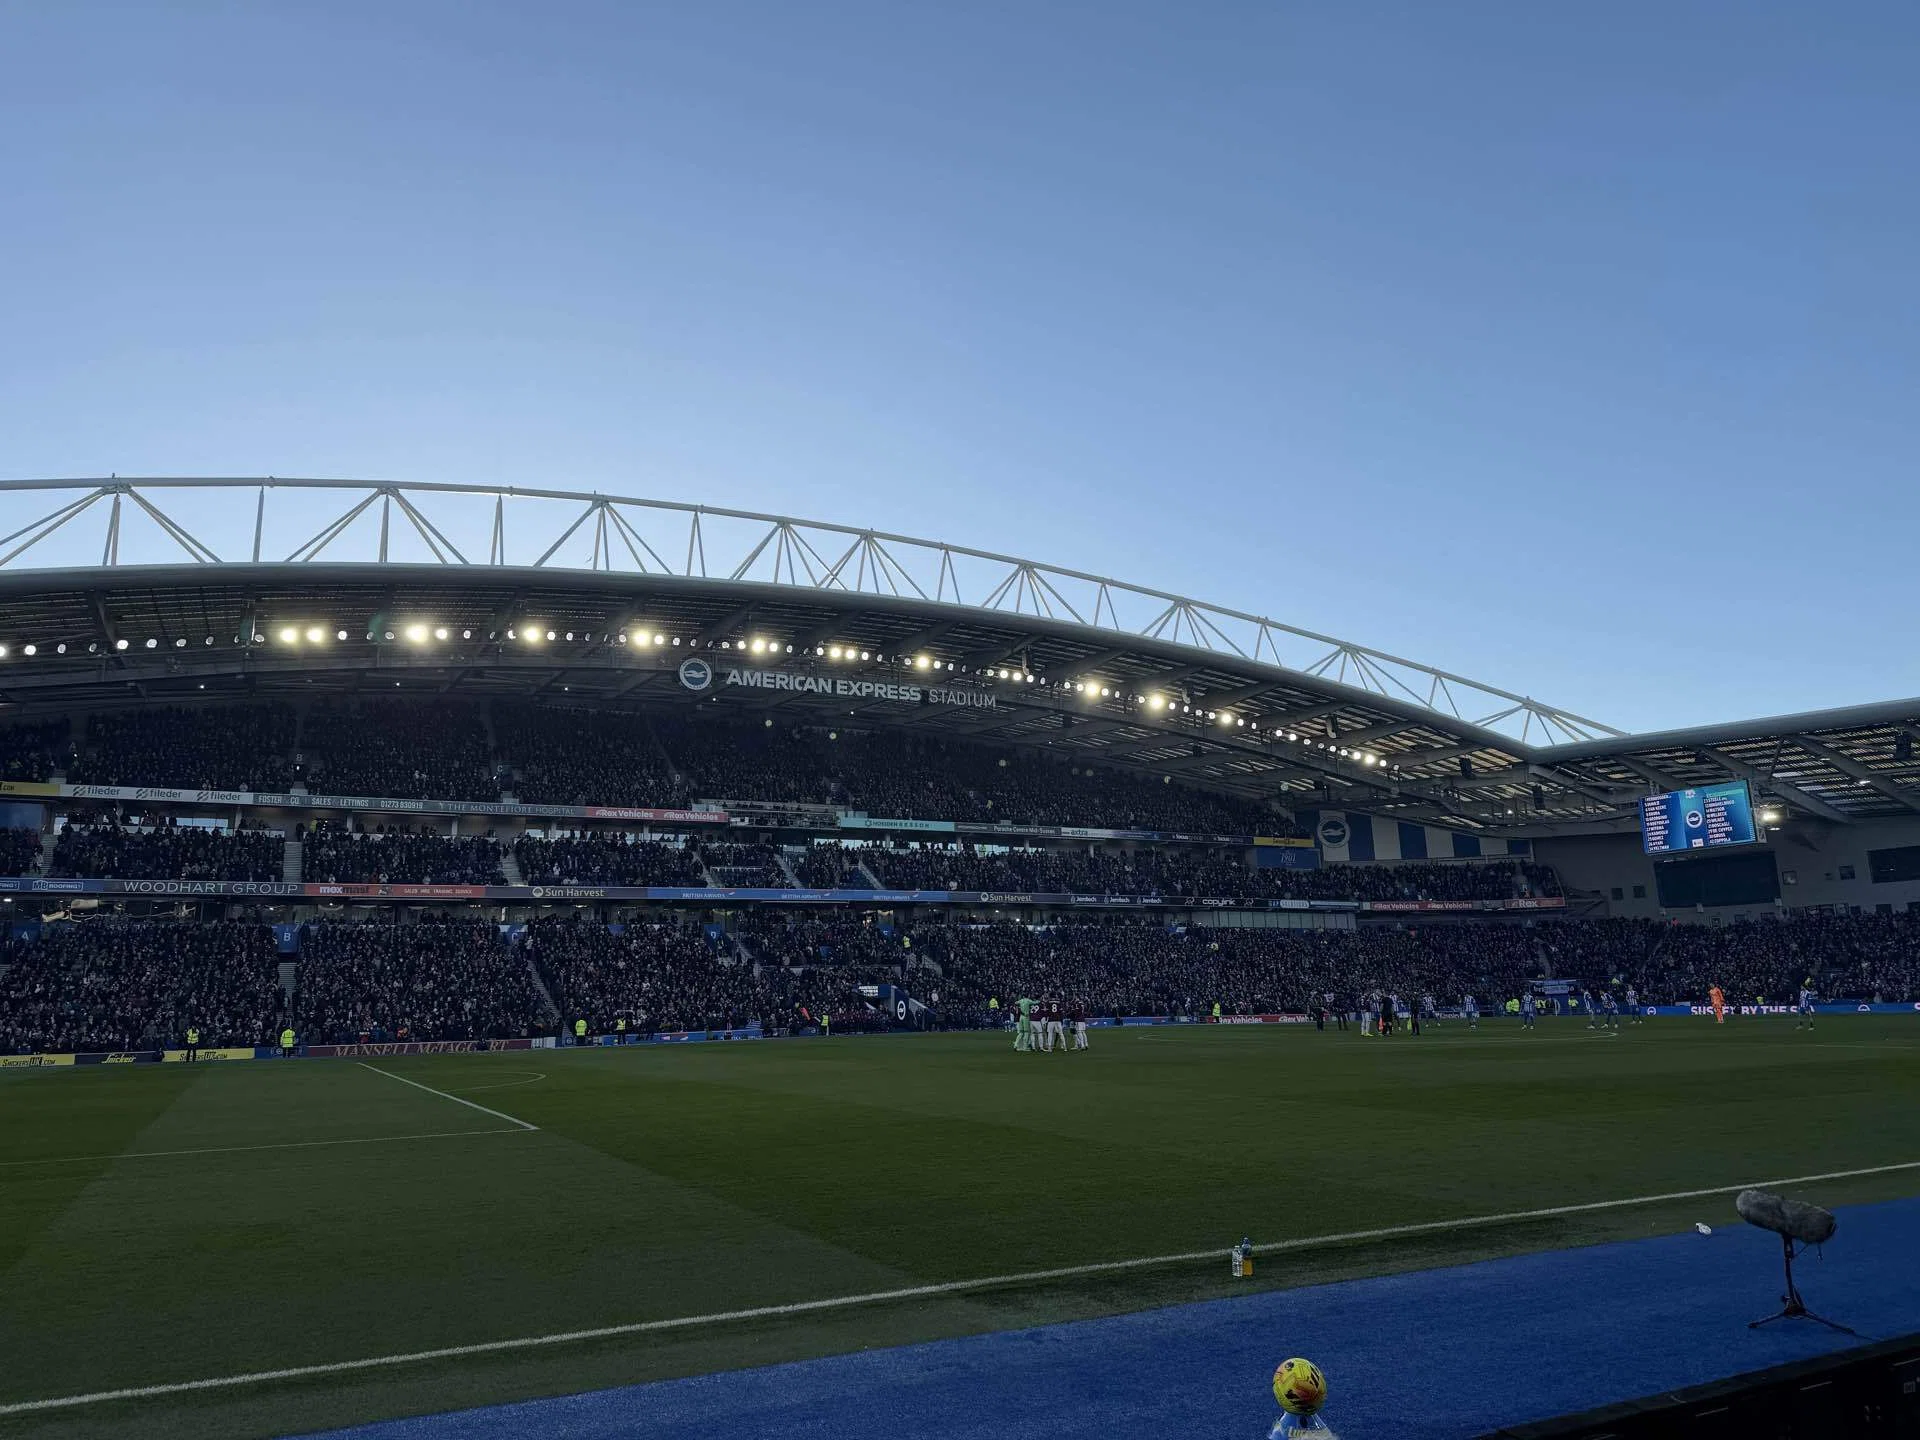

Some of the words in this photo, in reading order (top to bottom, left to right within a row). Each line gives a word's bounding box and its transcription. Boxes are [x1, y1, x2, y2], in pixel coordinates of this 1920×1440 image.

[727, 669, 832, 693] AMERICAN
[836, 679, 922, 702] EXPRESS
[928, 688, 997, 708] STADIUM
[87, 786, 121, 796] fileder
[149, 788, 182, 799] fileder
[210, 791, 241, 801] fileder
[258, 795, 282, 804] FOSTER
[312, 797, 332, 806] SALES
[340, 798, 369, 807] LETTINGS
[380, 800, 399, 808] 01273
[449, 803, 466, 811] THE
[470, 804, 532, 814] MONTEFIORE
[535, 807, 575, 815] HOSPITAL
[619, 809, 654, 818] Vehicles
[685, 812, 718, 821] Vehicles
[124, 881, 226, 894] WOODHART
[231, 882, 298, 894] GROUP
[544, 888, 564, 897] Sun
[567, 888, 605, 897] Harvest
[989, 894, 1003, 902] Sun
[1005, 894, 1032, 902] Harvest
[1443, 901, 1473, 909] Vehicles
[283, 932, 291, 942] B
[1030, 1004, 1040, 1014] 29
[1051, 1003, 1058, 1013] 8
[1690, 1005, 1735, 1015] SUSEX
[1760, 1005, 1787, 1015] THE
[1231, 1015, 1263, 1024] Vehicles
[334, 1045, 408, 1056] MANSELL
[416, 1040, 509, 1054] McTAGGRT
